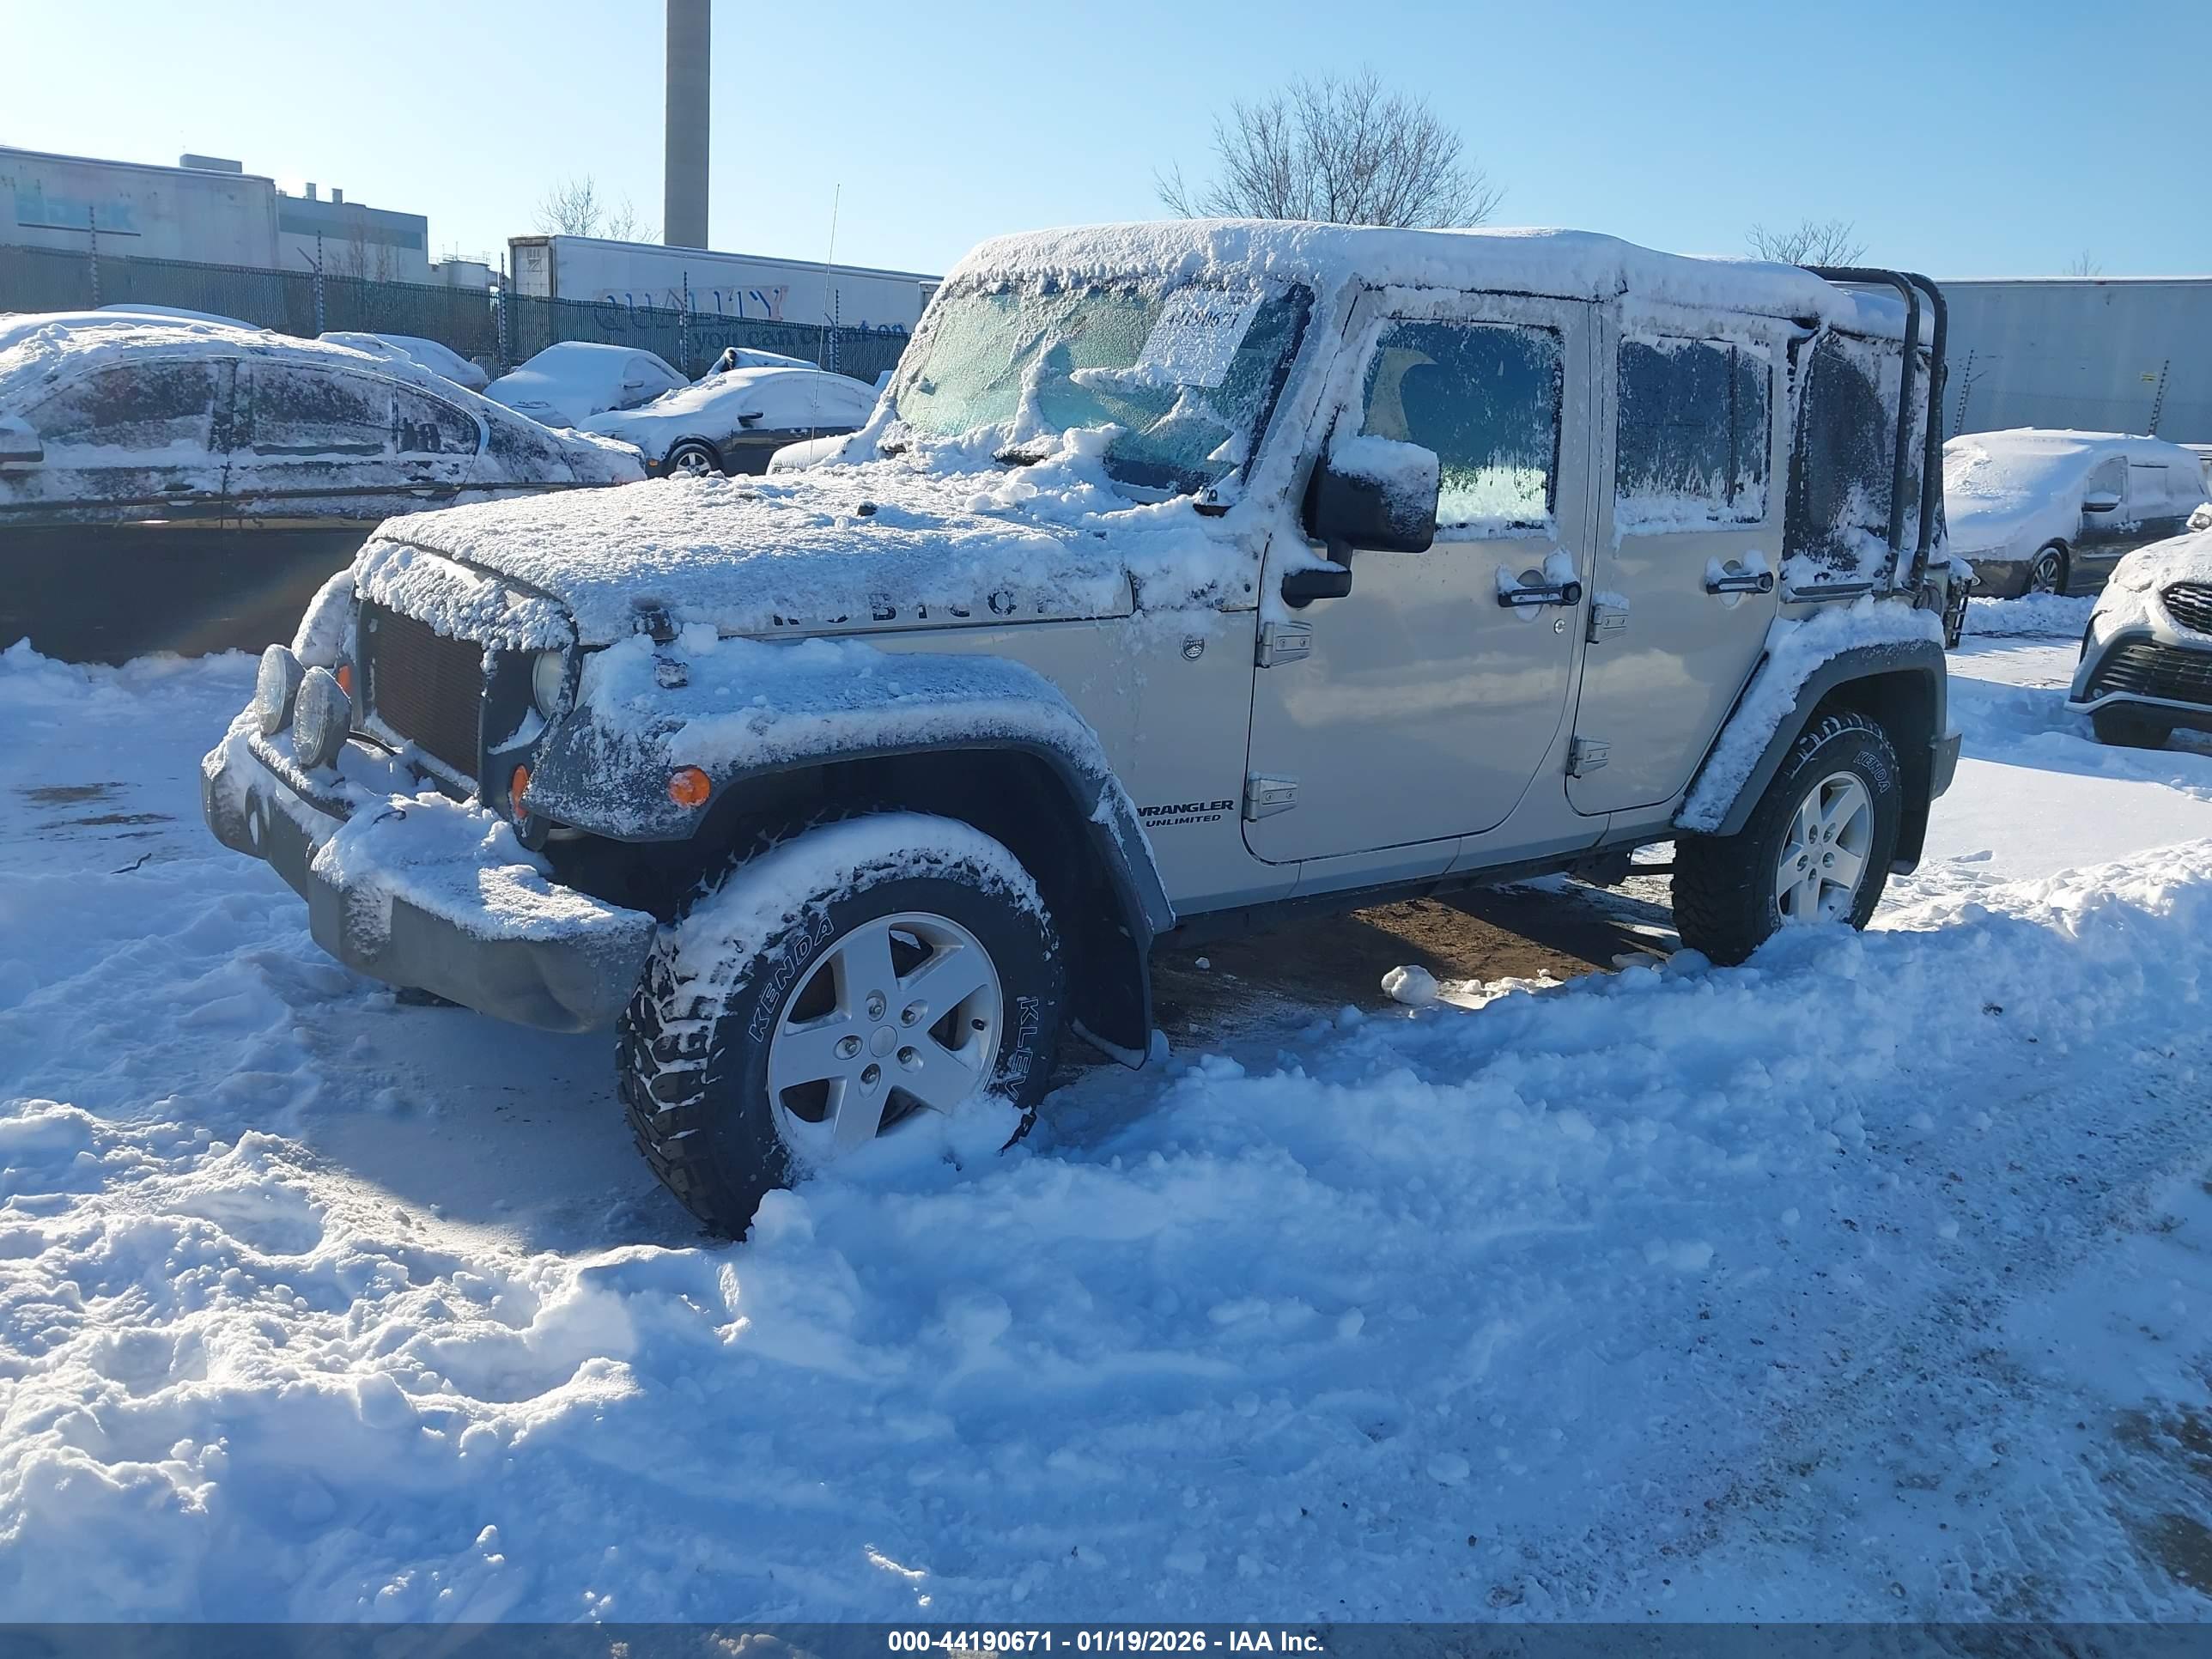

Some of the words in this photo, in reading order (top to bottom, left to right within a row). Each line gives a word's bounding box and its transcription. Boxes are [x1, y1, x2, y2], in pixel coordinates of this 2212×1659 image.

[1853, 750, 1891, 794] KENDA
[1137, 799, 1235, 817] WRANGLER
[1145, 814, 1221, 828] UNLIMITED
[748, 916, 835, 1043] KENDA
